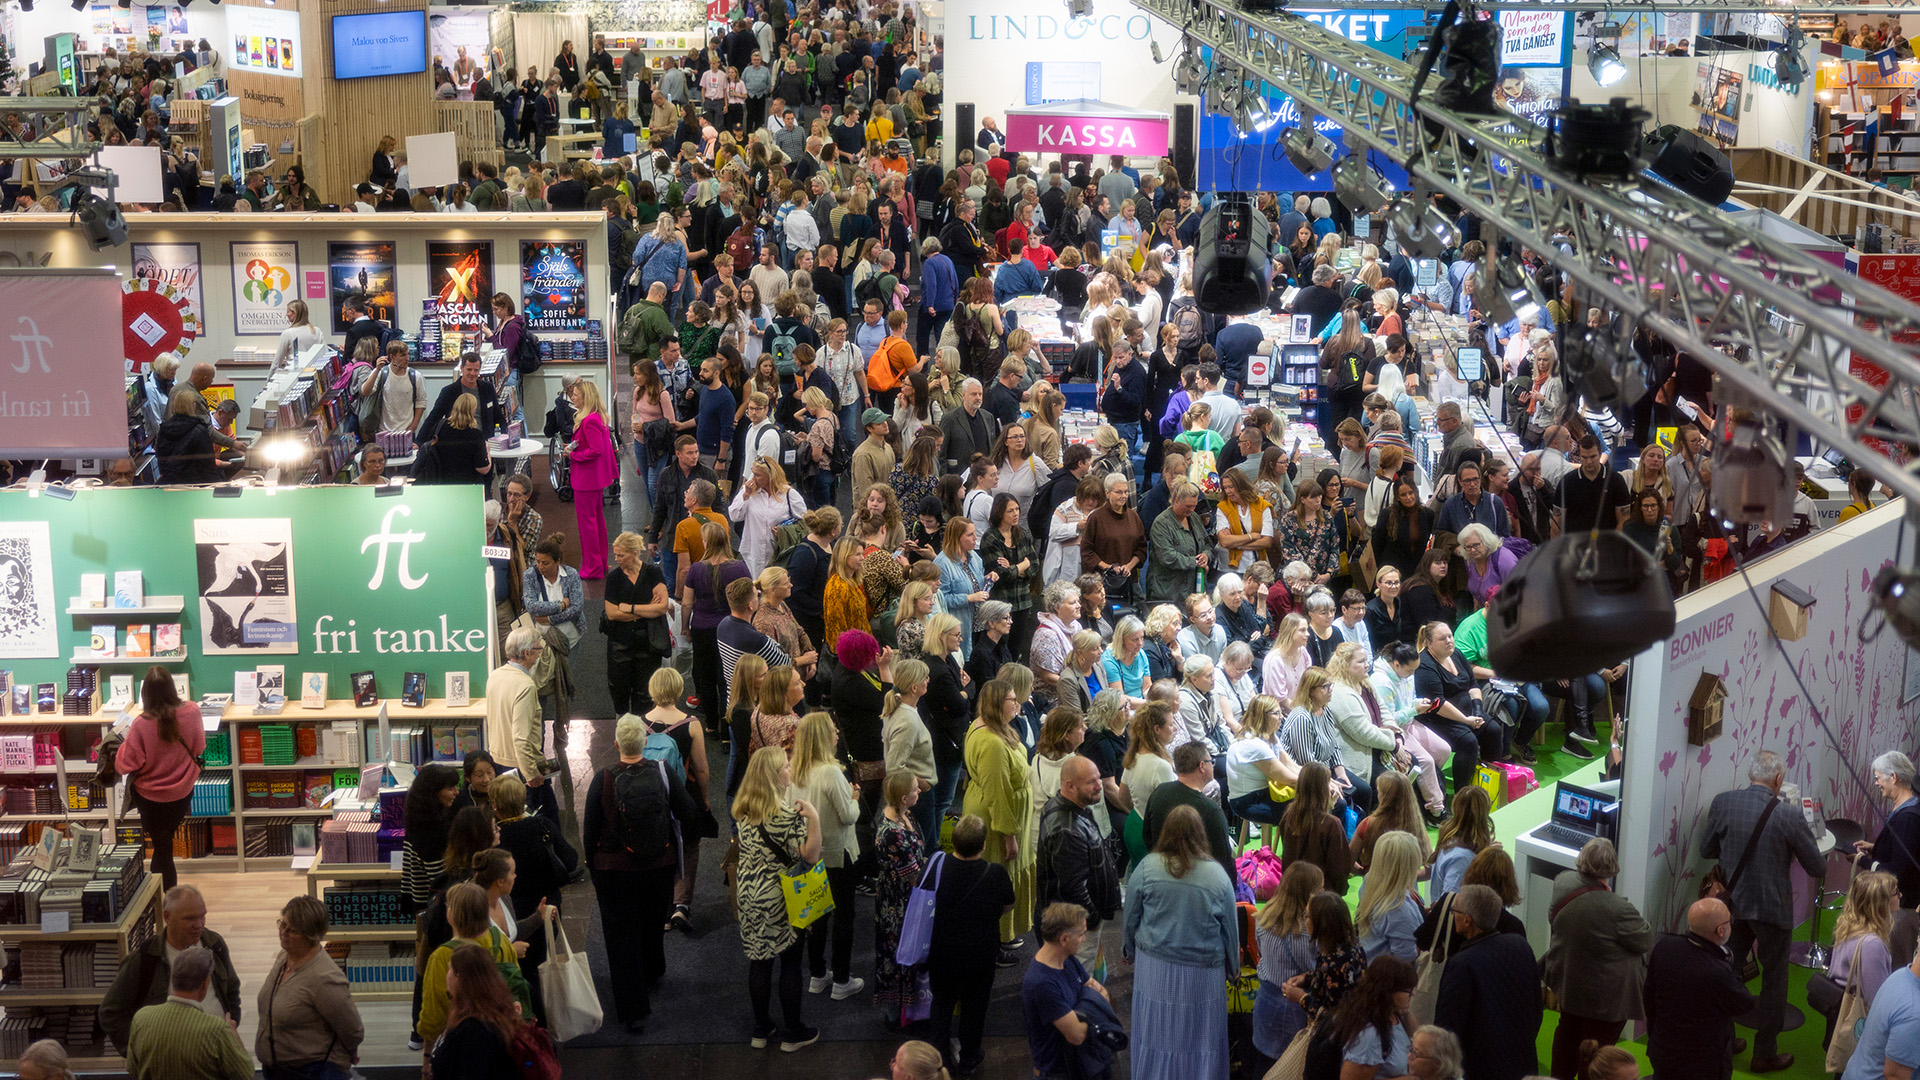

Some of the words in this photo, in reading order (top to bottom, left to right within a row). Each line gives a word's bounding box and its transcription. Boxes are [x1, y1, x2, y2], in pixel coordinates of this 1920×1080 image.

[1507, 28, 1530, 39] som
[1530, 22, 1552, 37] dog
[352, 36, 375, 47] Malou
[389, 34, 409, 44] Sivers
[1505, 36, 1521, 53] TVÅ
[1522, 32, 1556, 51] GÅNGER
[1839, 69, 1920, 85] SÖFARTS
[244, 88, 285, 107] Boksignering
[1038, 124, 1137, 148] KASSA
[144, 264, 192, 285] ÖDET
[537, 255, 571, 278] Själs
[530, 273, 580, 295] fränden
[241, 312, 282, 320] OMGIVEN
[440, 314, 488, 325] NGMAN
[543, 309, 567, 318] SOFIE
[241, 318, 292, 326] ENERGITJUVA
[528, 318, 582, 327] SARENBRANT
[200, 528, 230, 538] Sans
[484, 548, 508, 557] B03:22
[313, 615, 360, 654] fri
[373, 614, 486, 653] tanke
[1671, 612, 1734, 661] BONNIER
[339, 775, 358, 786] FÖR
[805, 890, 828, 908] ROONEY
[809, 885, 824, 898] SALLY
